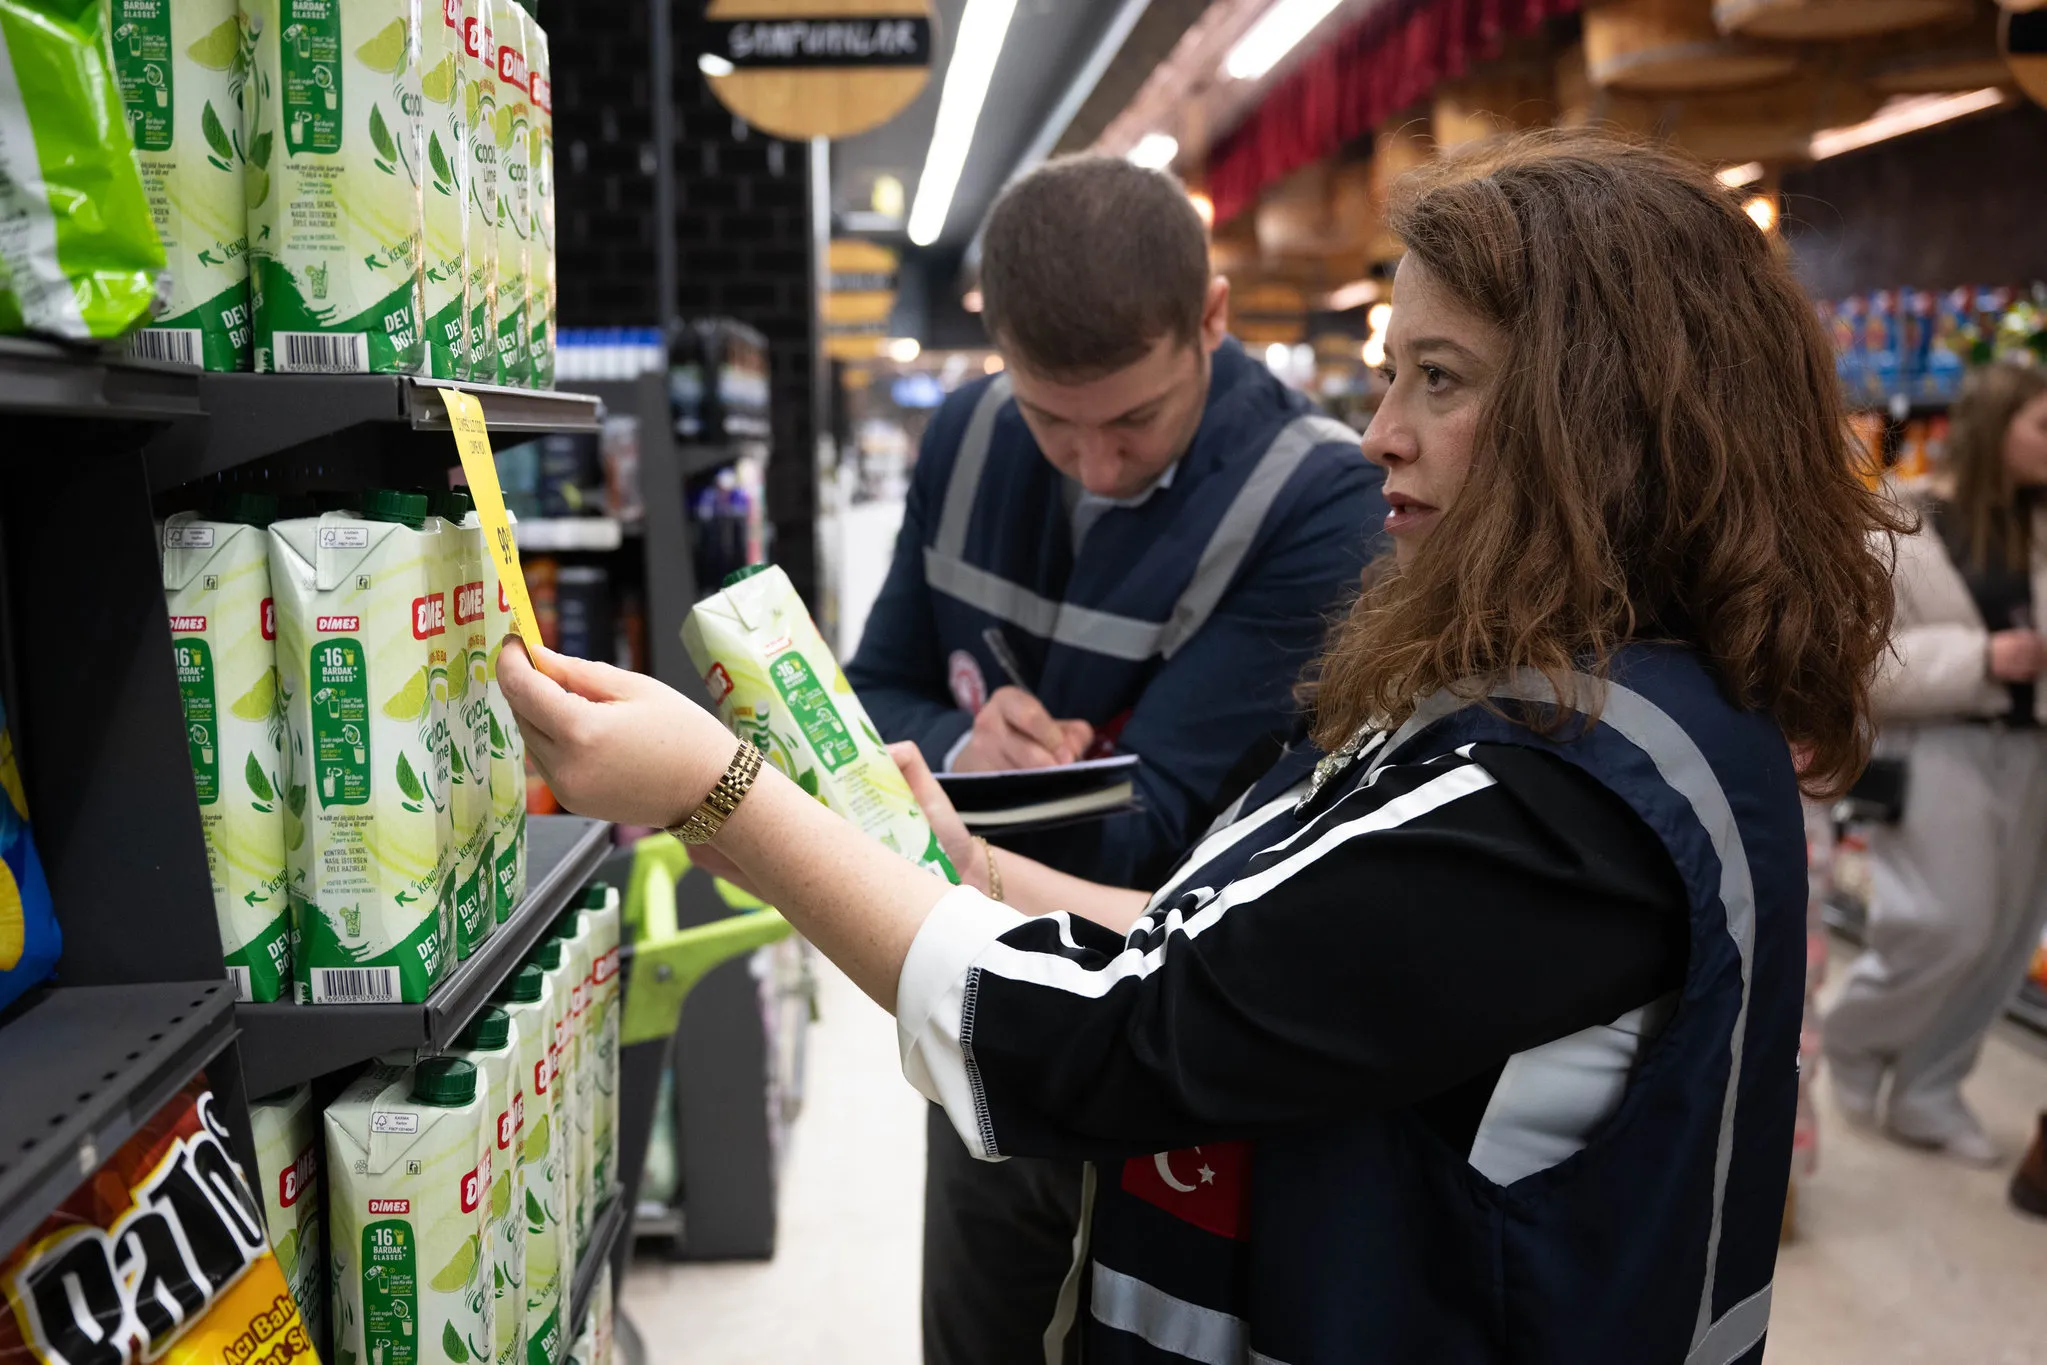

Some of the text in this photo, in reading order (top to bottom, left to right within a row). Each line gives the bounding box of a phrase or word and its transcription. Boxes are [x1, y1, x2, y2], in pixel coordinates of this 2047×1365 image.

[384, 306, 410, 333] DEV
[389, 327, 414, 352] BOY
[458, 891, 478, 920] DEV
[464, 907, 481, 936] BOY
[416, 930, 439, 960] DEV
[424, 949, 441, 977] BOY
